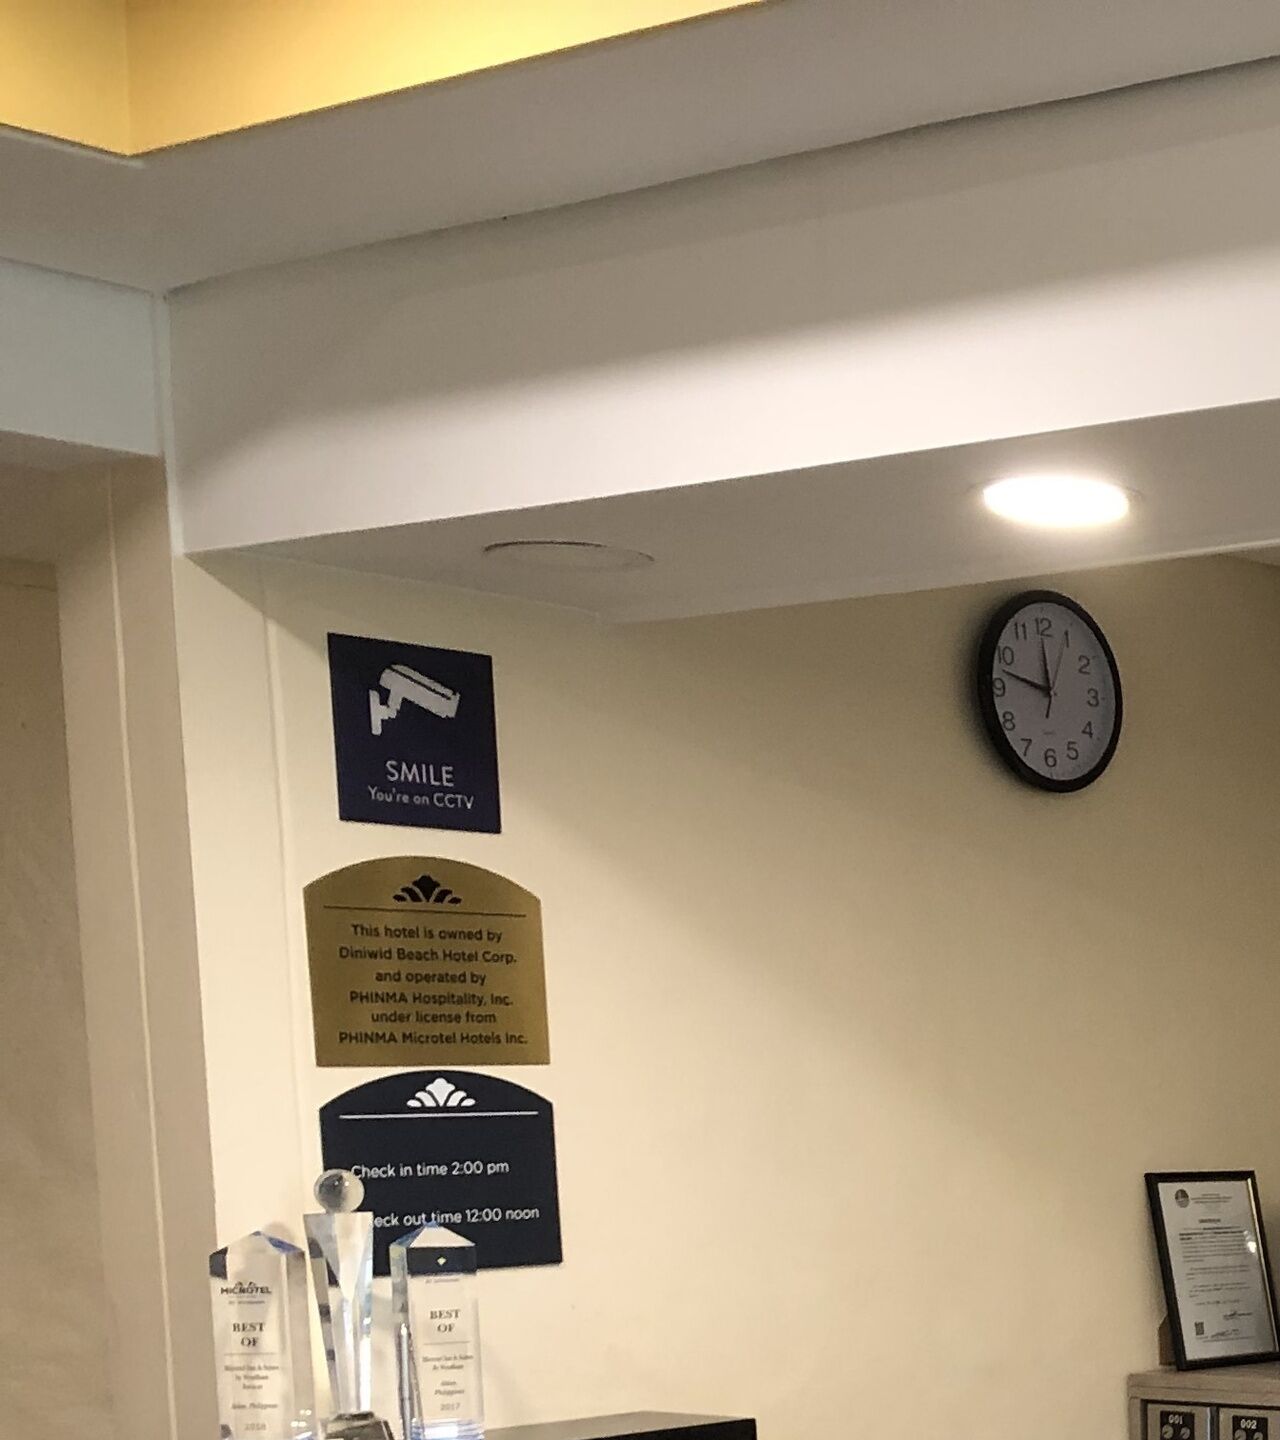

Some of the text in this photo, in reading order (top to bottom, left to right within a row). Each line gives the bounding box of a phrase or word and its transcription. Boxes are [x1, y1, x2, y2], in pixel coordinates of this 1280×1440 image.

[1014, 622, 1027, 640] 11
[1035, 617, 1052, 637] 12
[997, 645, 1014, 666] 10
[1078, 655, 1091, 675] 2
[992, 677, 1006, 698] 9
[1087, 688, 1099, 708] 3
[1003, 711, 1015, 731] 8
[1082, 721, 1093, 738] 4
[1021, 738, 1032, 756] 7
[1066, 741, 1079, 760] 5
[1044, 748, 1057, 768] 6
[386, 760, 454, 787] SMILE
[368, 785, 474, 809] You're on CCTV
[351, 923, 503, 944] This hotel is owned by
[338, 946, 517, 965] Diniwid Beach Hotel Corp.
[375, 971, 487, 987] and operated by
[350, 991, 408, 1005] PHINMA
[490, 993, 514, 1007] Inc.
[371, 1010, 496, 1024] under license from
[339, 1031, 528, 1045] PHINMA Microtel Hotels Inc.
[351, 1160, 510, 1179] Check in time 2:00 pm
[373, 1207, 540, 1228] eck out time 12:00 noon
[430, 1308, 462, 1320] BEST
[232, 1322, 266, 1333] BEST
[437, 1322, 456, 1334] OF
[240, 1335, 260, 1348] OF
[1169, 1414, 1183, 1424] 001
[1240, 1419, 1257, 1430] 002
